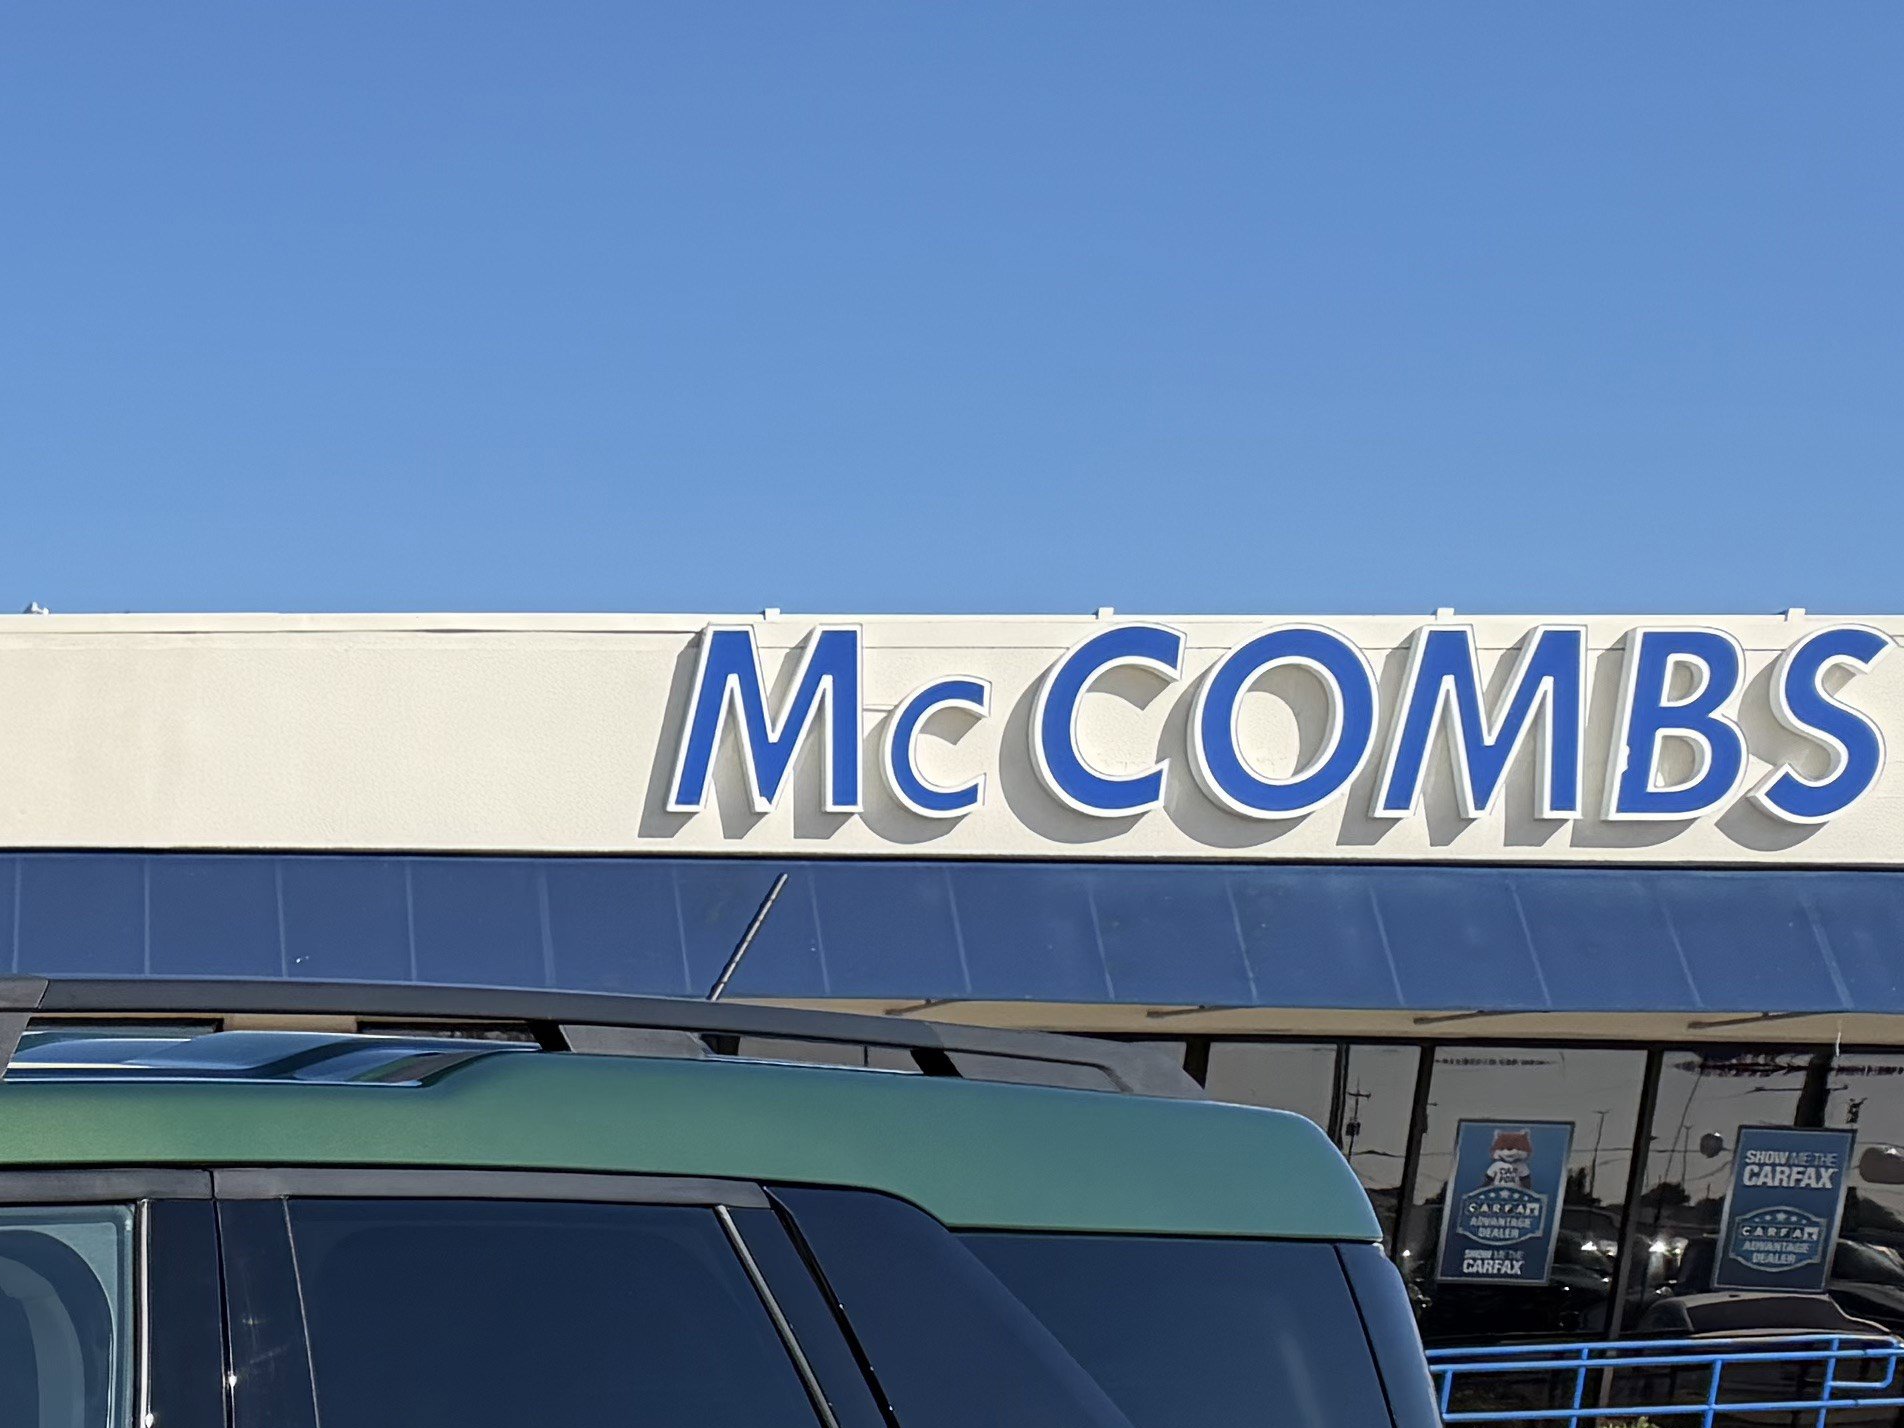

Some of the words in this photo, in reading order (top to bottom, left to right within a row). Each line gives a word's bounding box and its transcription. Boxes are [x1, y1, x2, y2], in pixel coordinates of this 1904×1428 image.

[1745, 1150, 1789, 1164] SHOW
[1814, 1153, 1838, 1167] THE
[1742, 1164, 1836, 1189] CARFAX
[1462, 1259, 1525, 1275] CARFAX
